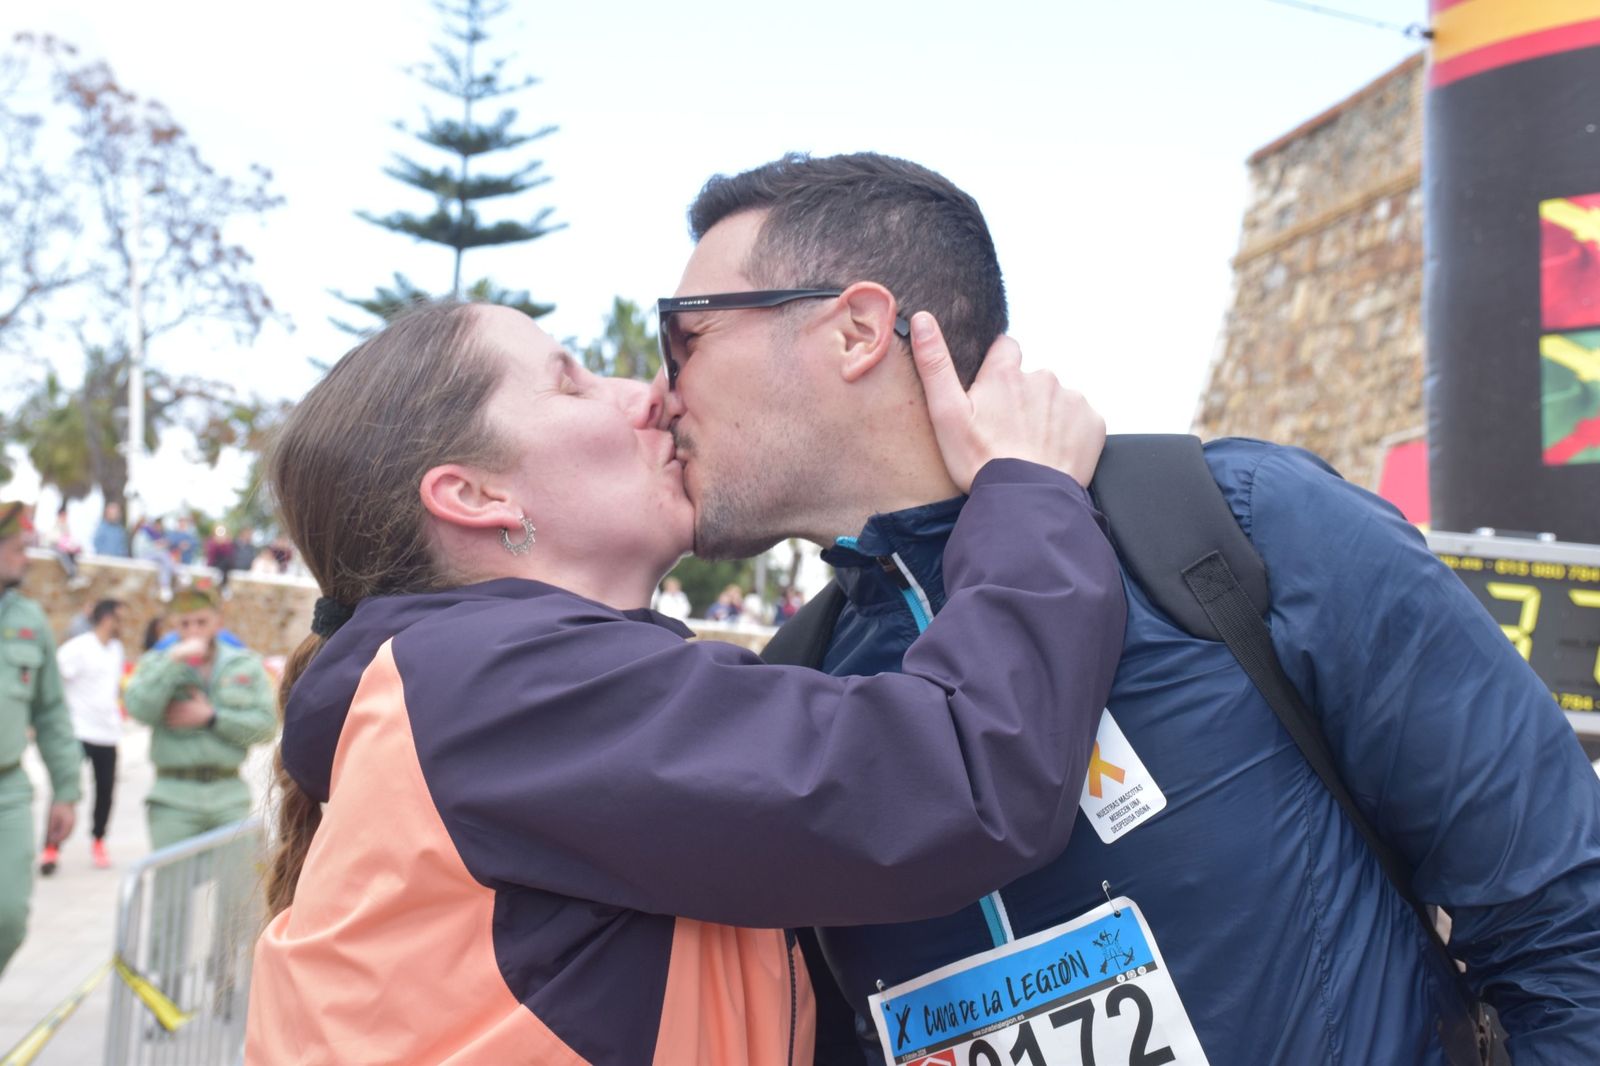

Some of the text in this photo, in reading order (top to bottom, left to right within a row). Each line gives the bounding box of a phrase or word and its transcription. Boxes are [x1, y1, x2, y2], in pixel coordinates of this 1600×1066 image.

[1096, 784, 1143, 818] NUESTRAS MASCOTAS
[1109, 798, 1141, 822] MERECEN UNA
[1110, 804, 1151, 834] DESPEDIDA DIGNA
[895, 1003, 911, 1050] X
[1005, 949, 1089, 1007] LEGIÓN
